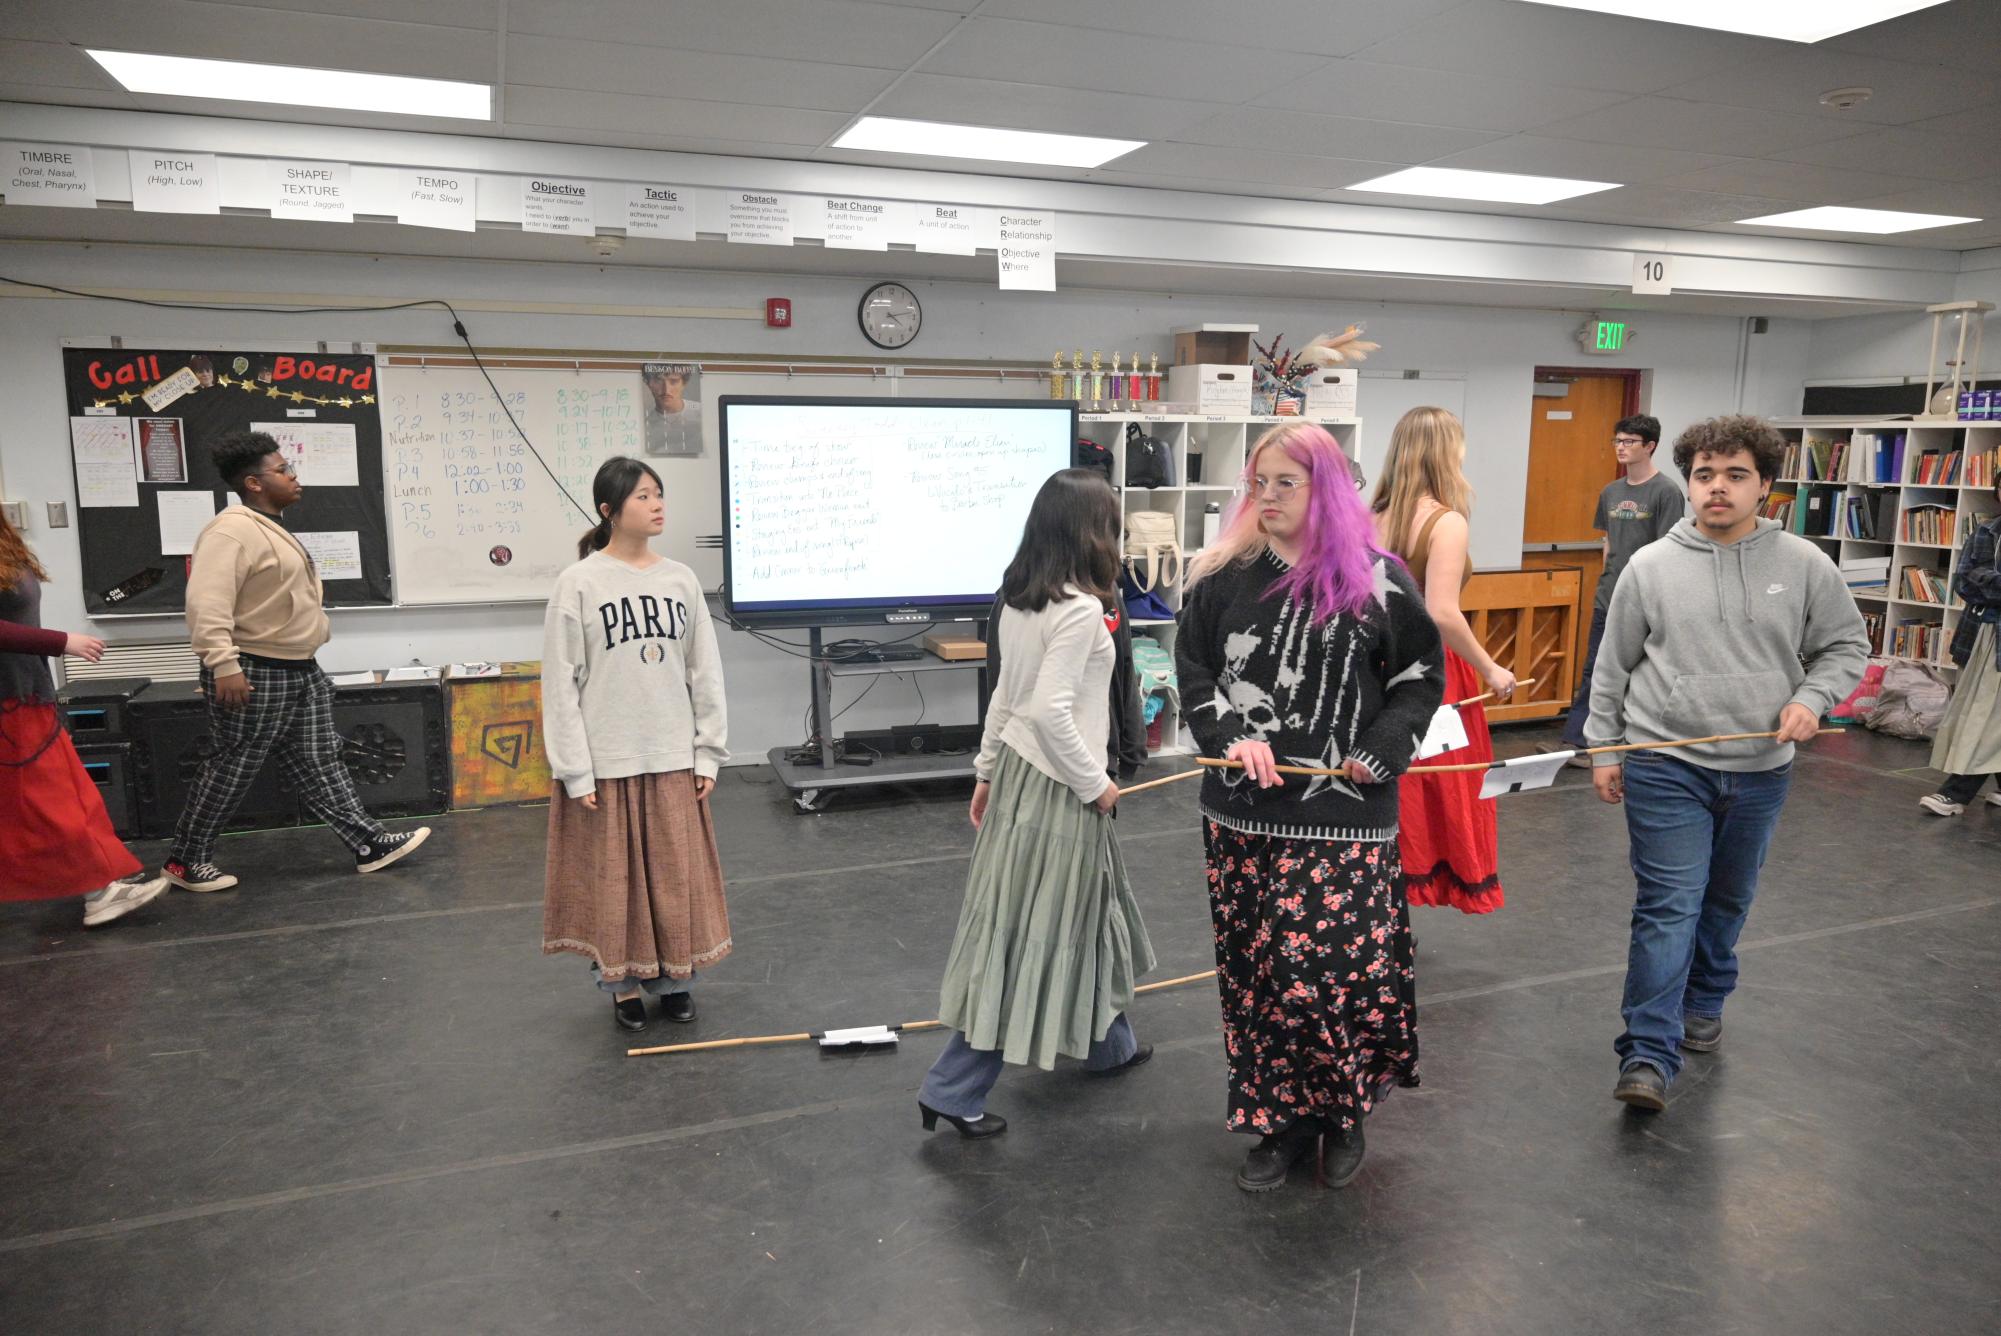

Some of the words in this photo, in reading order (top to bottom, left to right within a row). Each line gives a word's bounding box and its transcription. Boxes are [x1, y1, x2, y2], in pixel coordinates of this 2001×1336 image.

[20, 151, 72, 164] TIMBRE
[154, 160, 194, 172] PITCH
[18, 168, 46, 180] (Oral,
[48, 169, 77, 180] Nasal,
[287, 168, 333, 181] SHAPE/
[11, 179, 43, 190] Chest,
[44, 180, 86, 193] Pharynx)
[147, 176, 176, 188] (High,
[178, 177, 203, 188] Low)
[416, 176, 459, 189] TEMPO
[282, 184, 340, 197] TEXTURE
[531, 181, 586, 197] Objective
[644, 187, 677, 201] Tactic
[313, 200, 345, 210] Jagged)
[439, 193, 464, 206] Slow)
[525, 194, 541, 202] What
[556, 198, 584, 206] character
[742, 194, 778, 205] Obstacle
[640, 202, 659, 210] action
[730, 204, 761, 214] Something
[761, 207, 772, 215] you
[827, 200, 847, 211] Beat
[850, 201, 884, 214] Change
[629, 211, 654, 219] achieve
[655, 213, 670, 221] your
[849, 214, 863, 222] from
[935, 208, 958, 219] Beat
[835, 223, 855, 231] action
[918, 218, 924, 227] A
[926, 220, 939, 228] unit
[940, 220, 947, 228] of
[949, 221, 970, 230] action
[1000, 216, 1042, 227] Character
[756, 224, 784, 232] achieving
[1000, 230, 1053, 242] Relationship
[1001, 248, 1040, 260] Objective
[1001, 262, 1029, 272] Where
[1643, 261, 1664, 281] 10
[1597, 322, 1625, 349] EXIT
[88, 354, 160, 390] Call
[272, 356, 373, 390] Board
[389, 430, 436, 447] Nutrition
[394, 484, 433, 498] Lunch
[599, 595, 687, 651] PARIS
